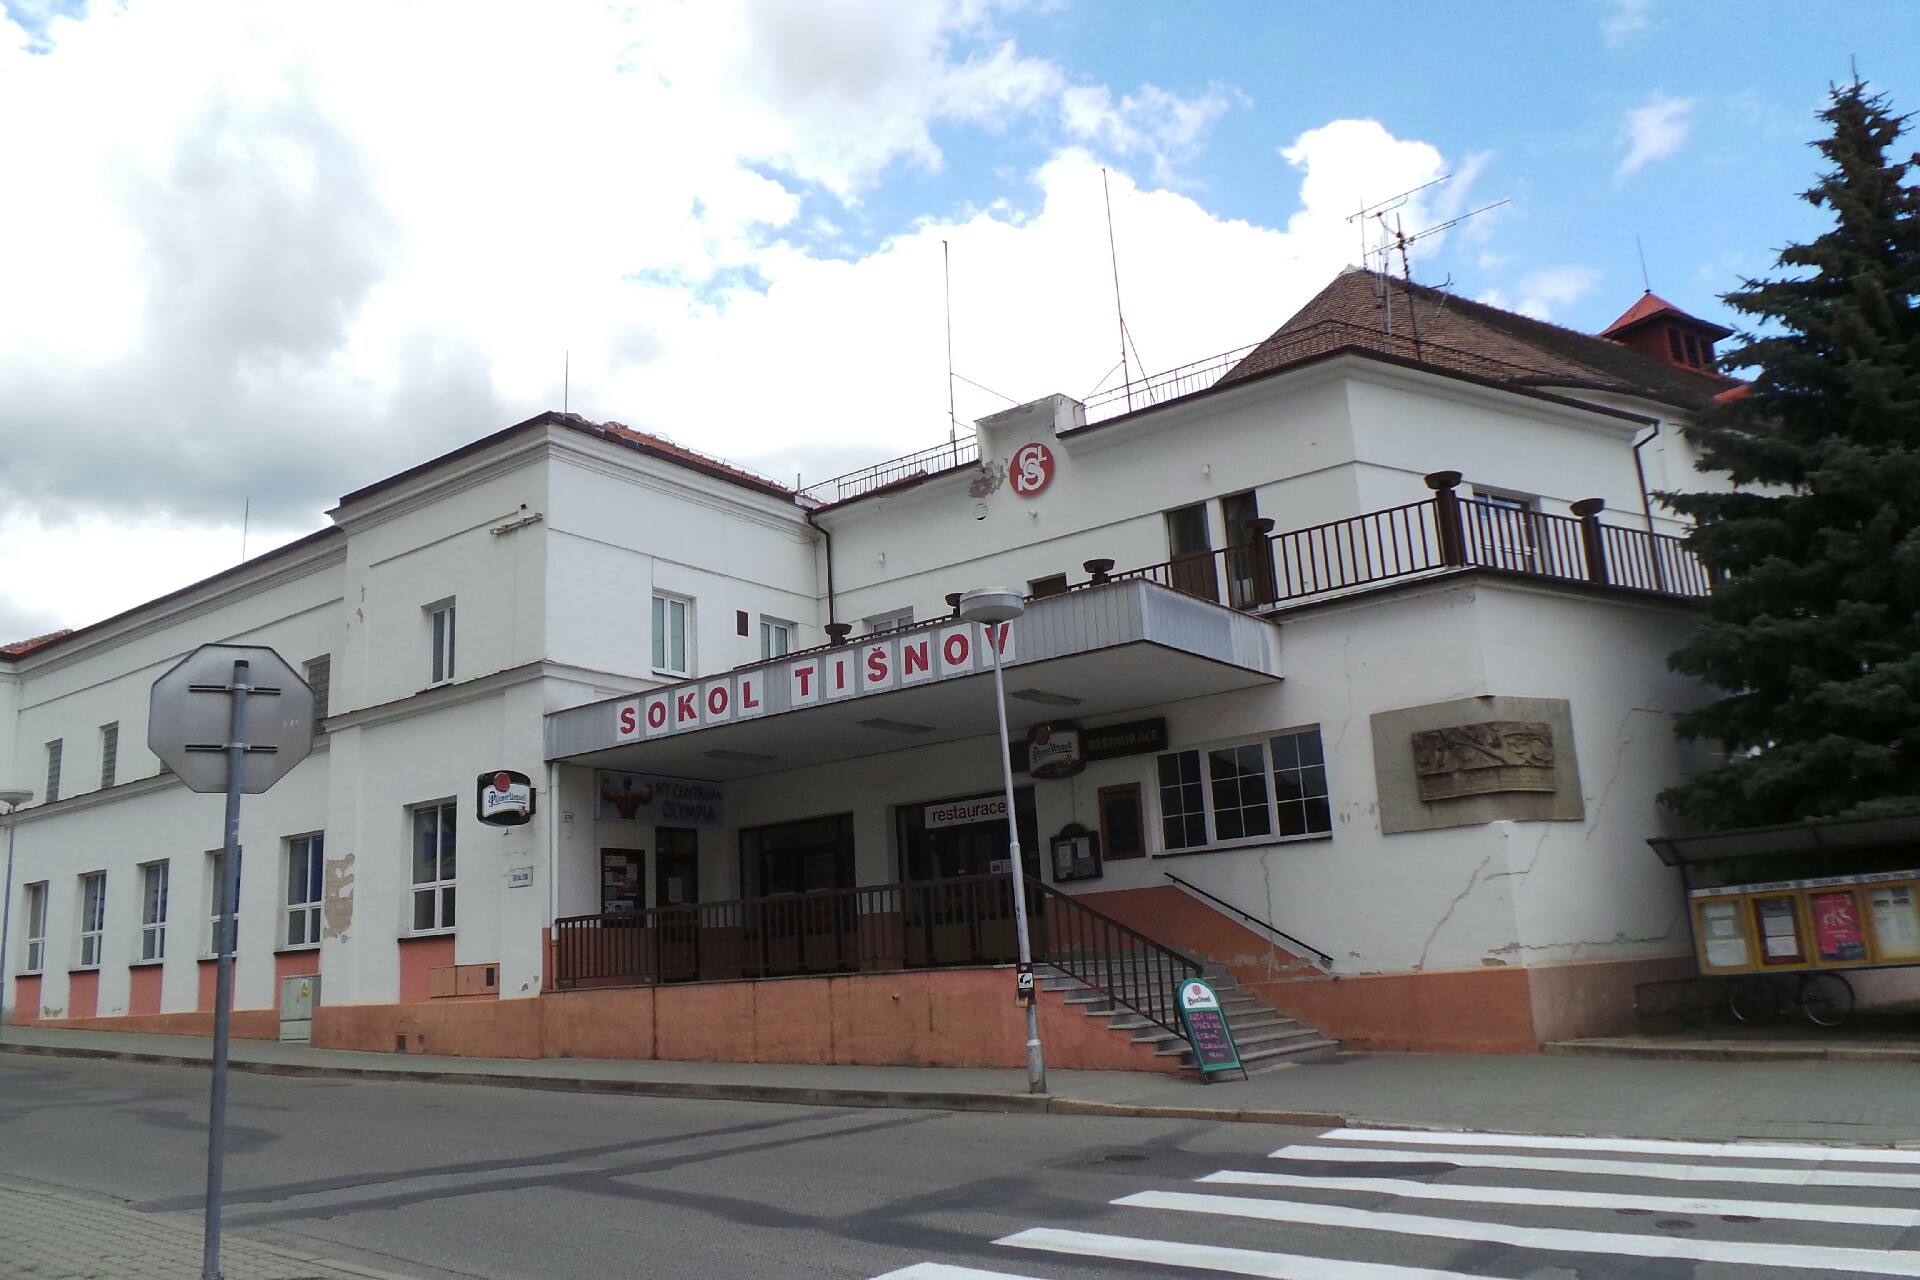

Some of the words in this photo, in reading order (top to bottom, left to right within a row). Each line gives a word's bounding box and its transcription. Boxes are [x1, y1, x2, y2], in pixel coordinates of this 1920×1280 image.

[620, 681, 760, 734] SOKOL
[795, 623, 1009, 696] TIŠNOV
[1088, 730, 1159, 751] RESTAURACE
[662, 801, 716, 822] OLYMPIA
[932, 801, 1006, 822] restaurace
